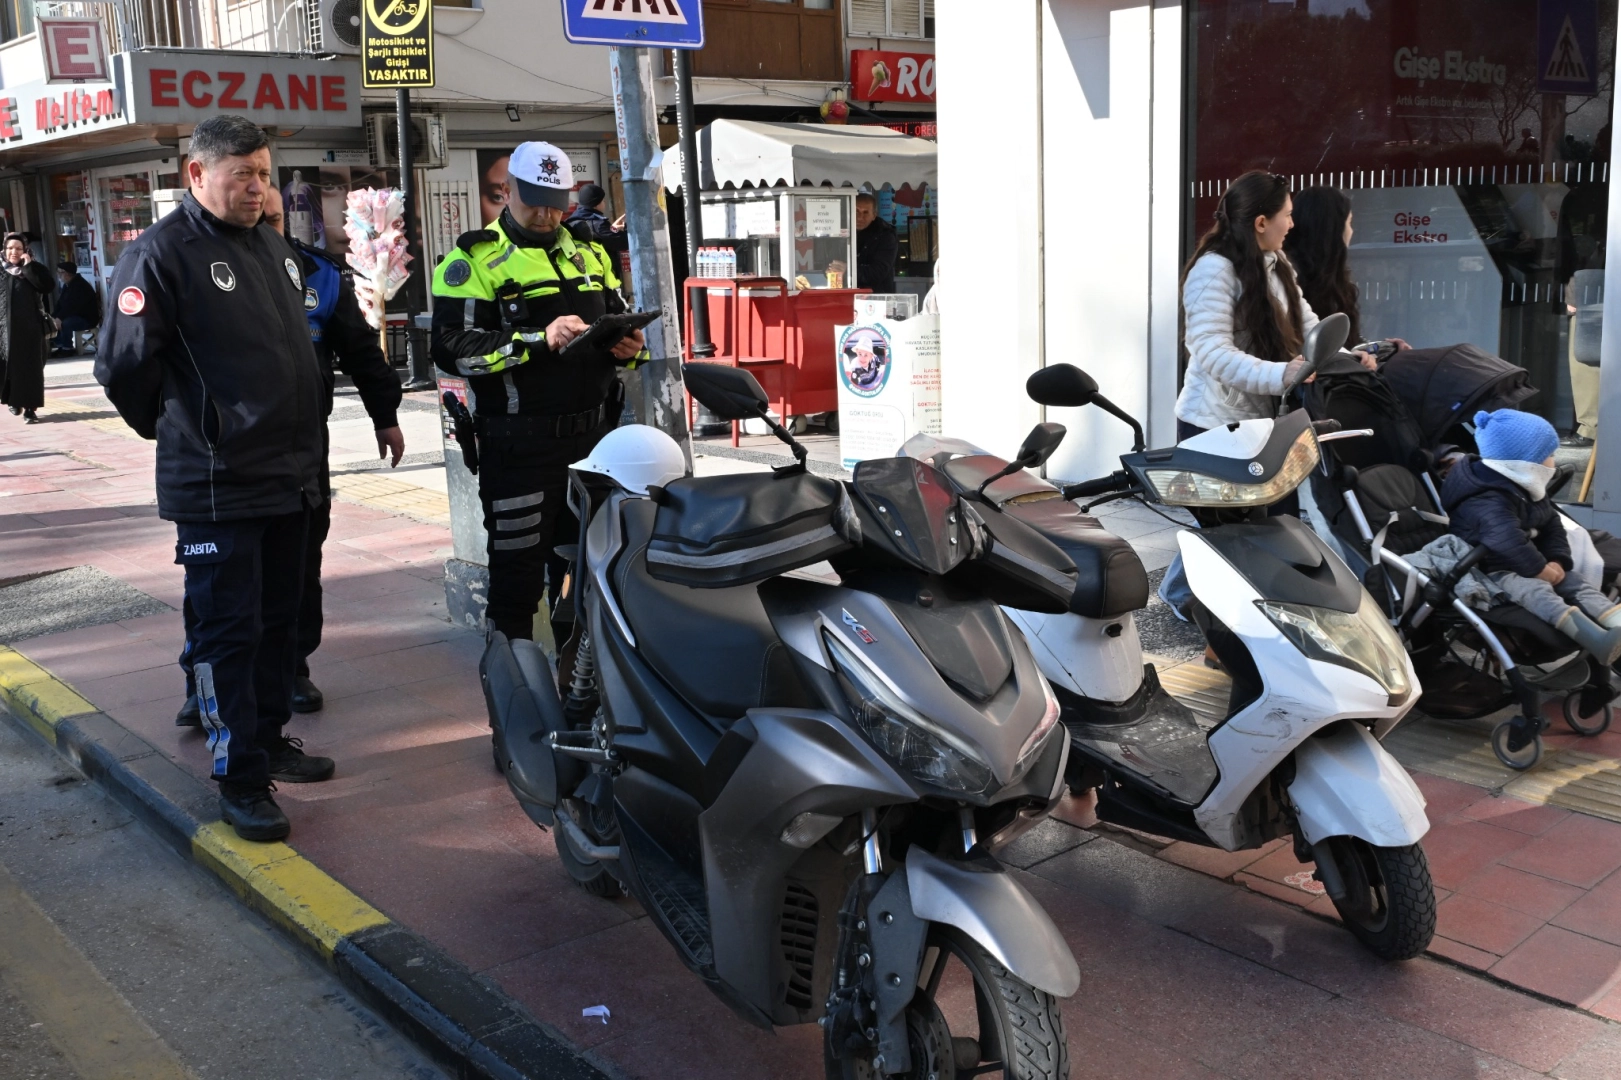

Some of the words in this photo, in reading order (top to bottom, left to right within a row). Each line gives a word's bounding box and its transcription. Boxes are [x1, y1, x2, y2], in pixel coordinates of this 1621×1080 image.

[368, 37, 414, 46] Motosiklet
[53, 28, 95, 73] E
[368, 48, 391, 59] Şarjlı
[393, 47, 427, 56] Bisiklet
[386, 58, 409, 68] Girişi
[1393, 46, 1440, 88] Gişe
[1443, 50, 1507, 86] Ekstra
[368, 69, 428, 80] YASAKTIR
[149, 68, 348, 112] ECZANE
[35, 87, 114, 131] Meltem
[571, 164, 587, 173] GÖZ
[536, 176, 561, 185] POLİS
[1393, 211, 1432, 230] Gişe
[1393, 230, 1449, 243] Ekstra
[183, 541, 218, 556] ZABITA
